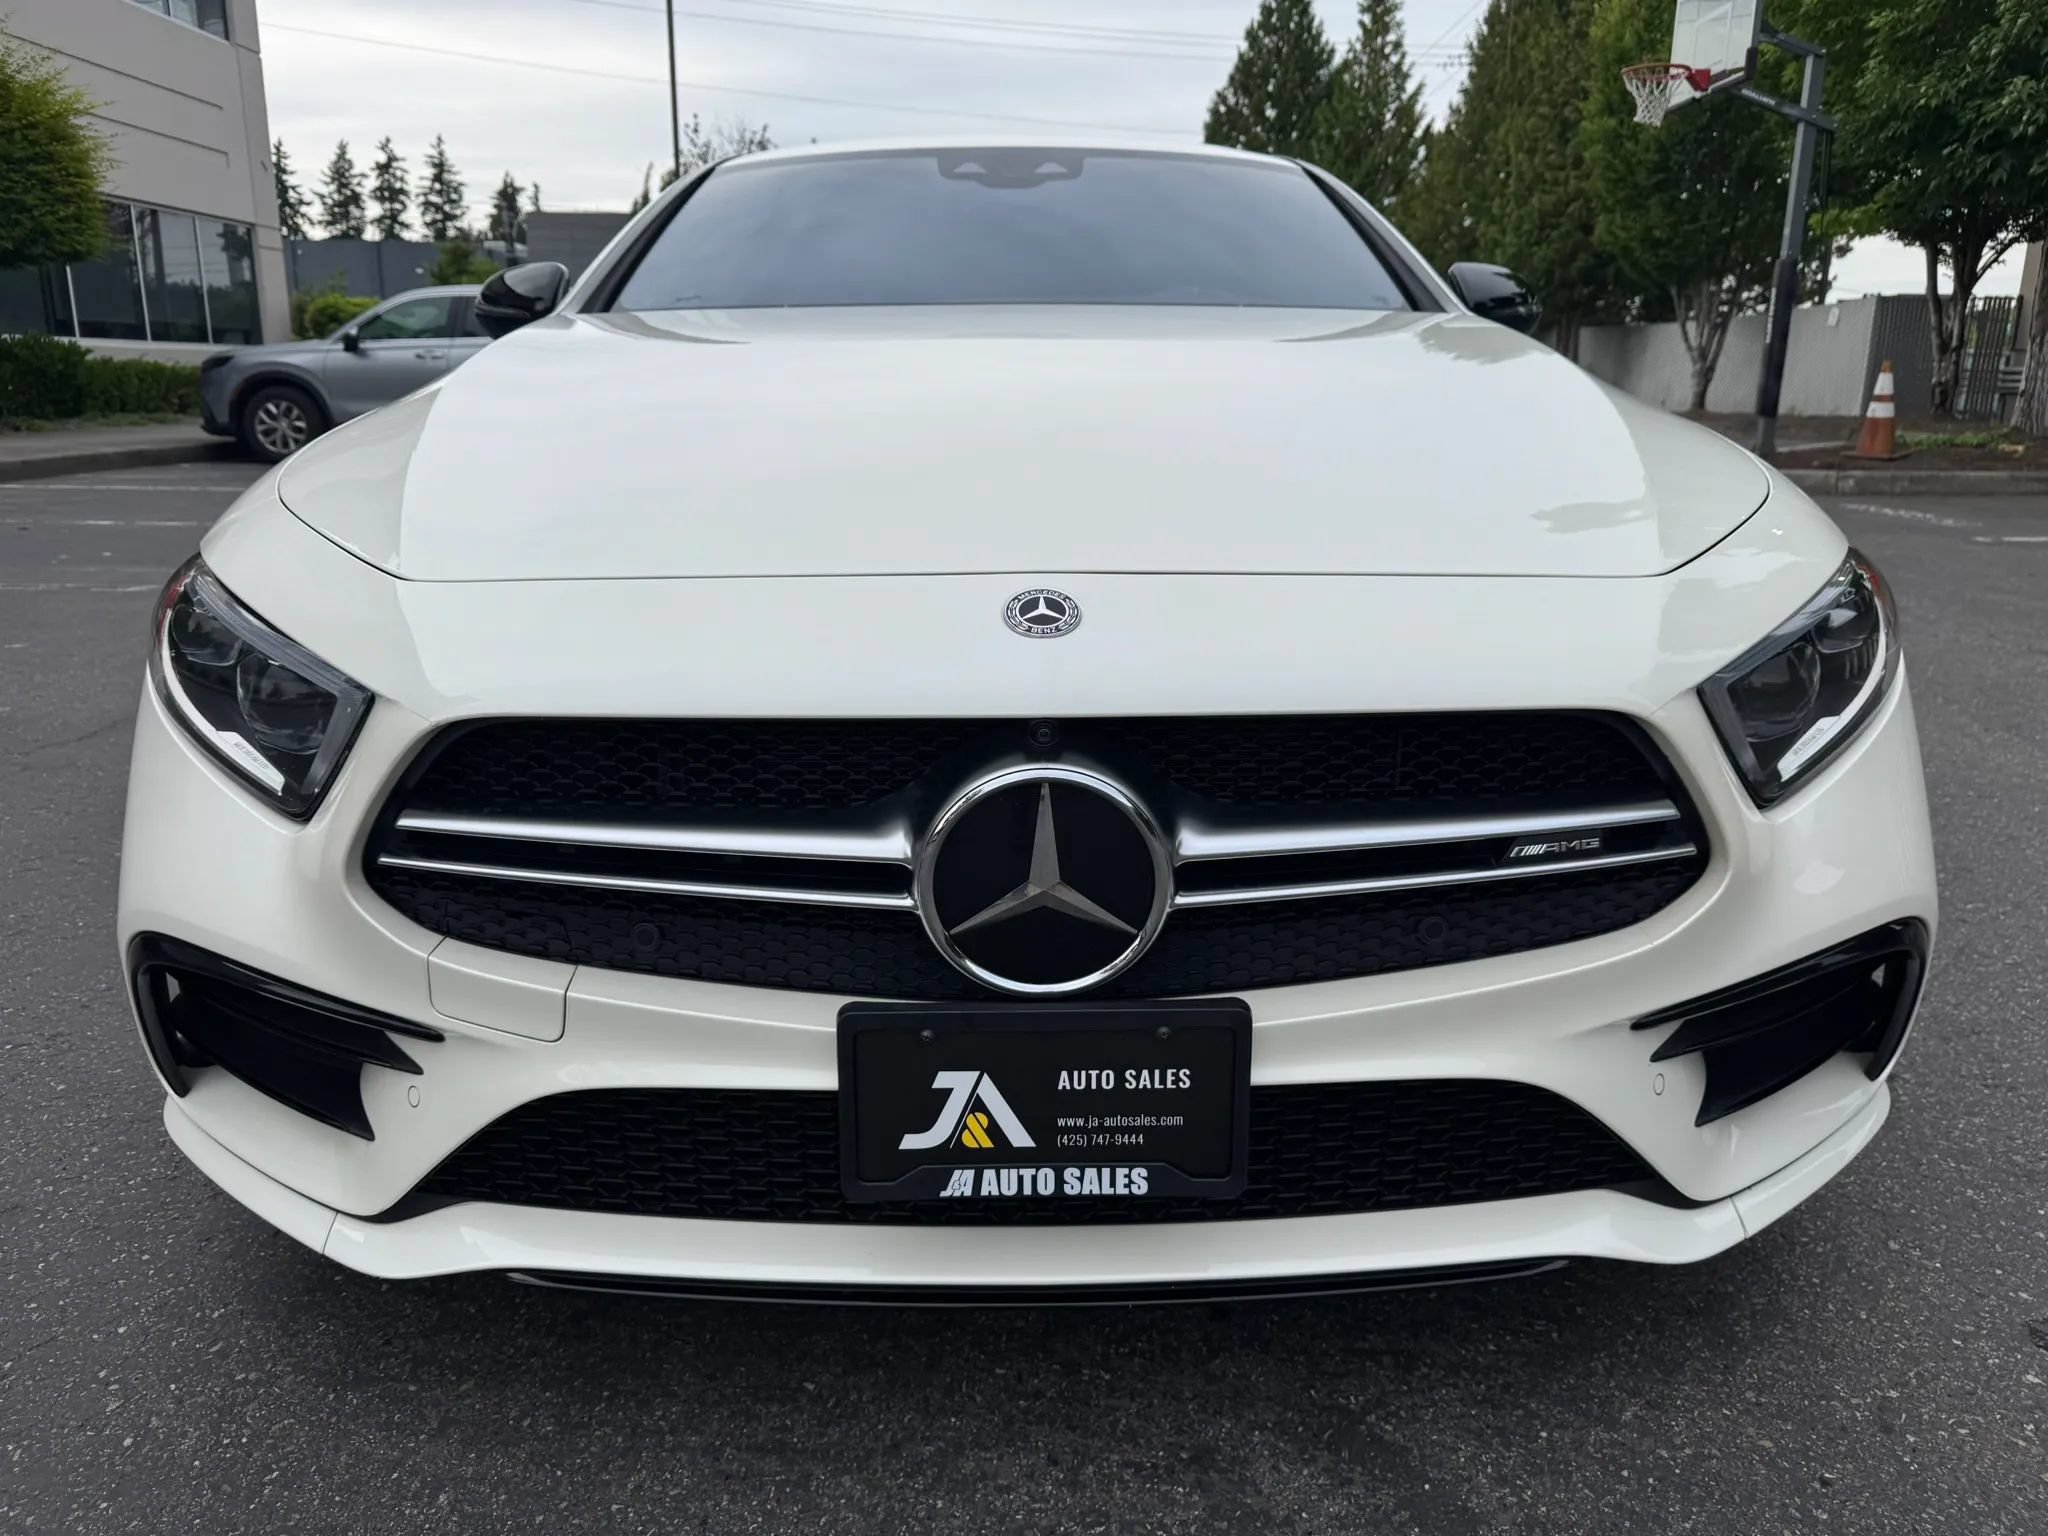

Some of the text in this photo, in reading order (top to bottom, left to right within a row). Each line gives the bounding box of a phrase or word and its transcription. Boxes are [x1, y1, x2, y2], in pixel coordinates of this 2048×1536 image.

[1031, 626, 1058, 634] BENZ
[1057, 1068, 1191, 1090] AUTO SALES
[1057, 1113, 1184, 1129] www.ja-autosales.com
[1057, 1133, 1144, 1148] (425) 747-9444
[981, 1168, 1056, 1196] AUTO
[1063, 1167, 1149, 1196] SALES
